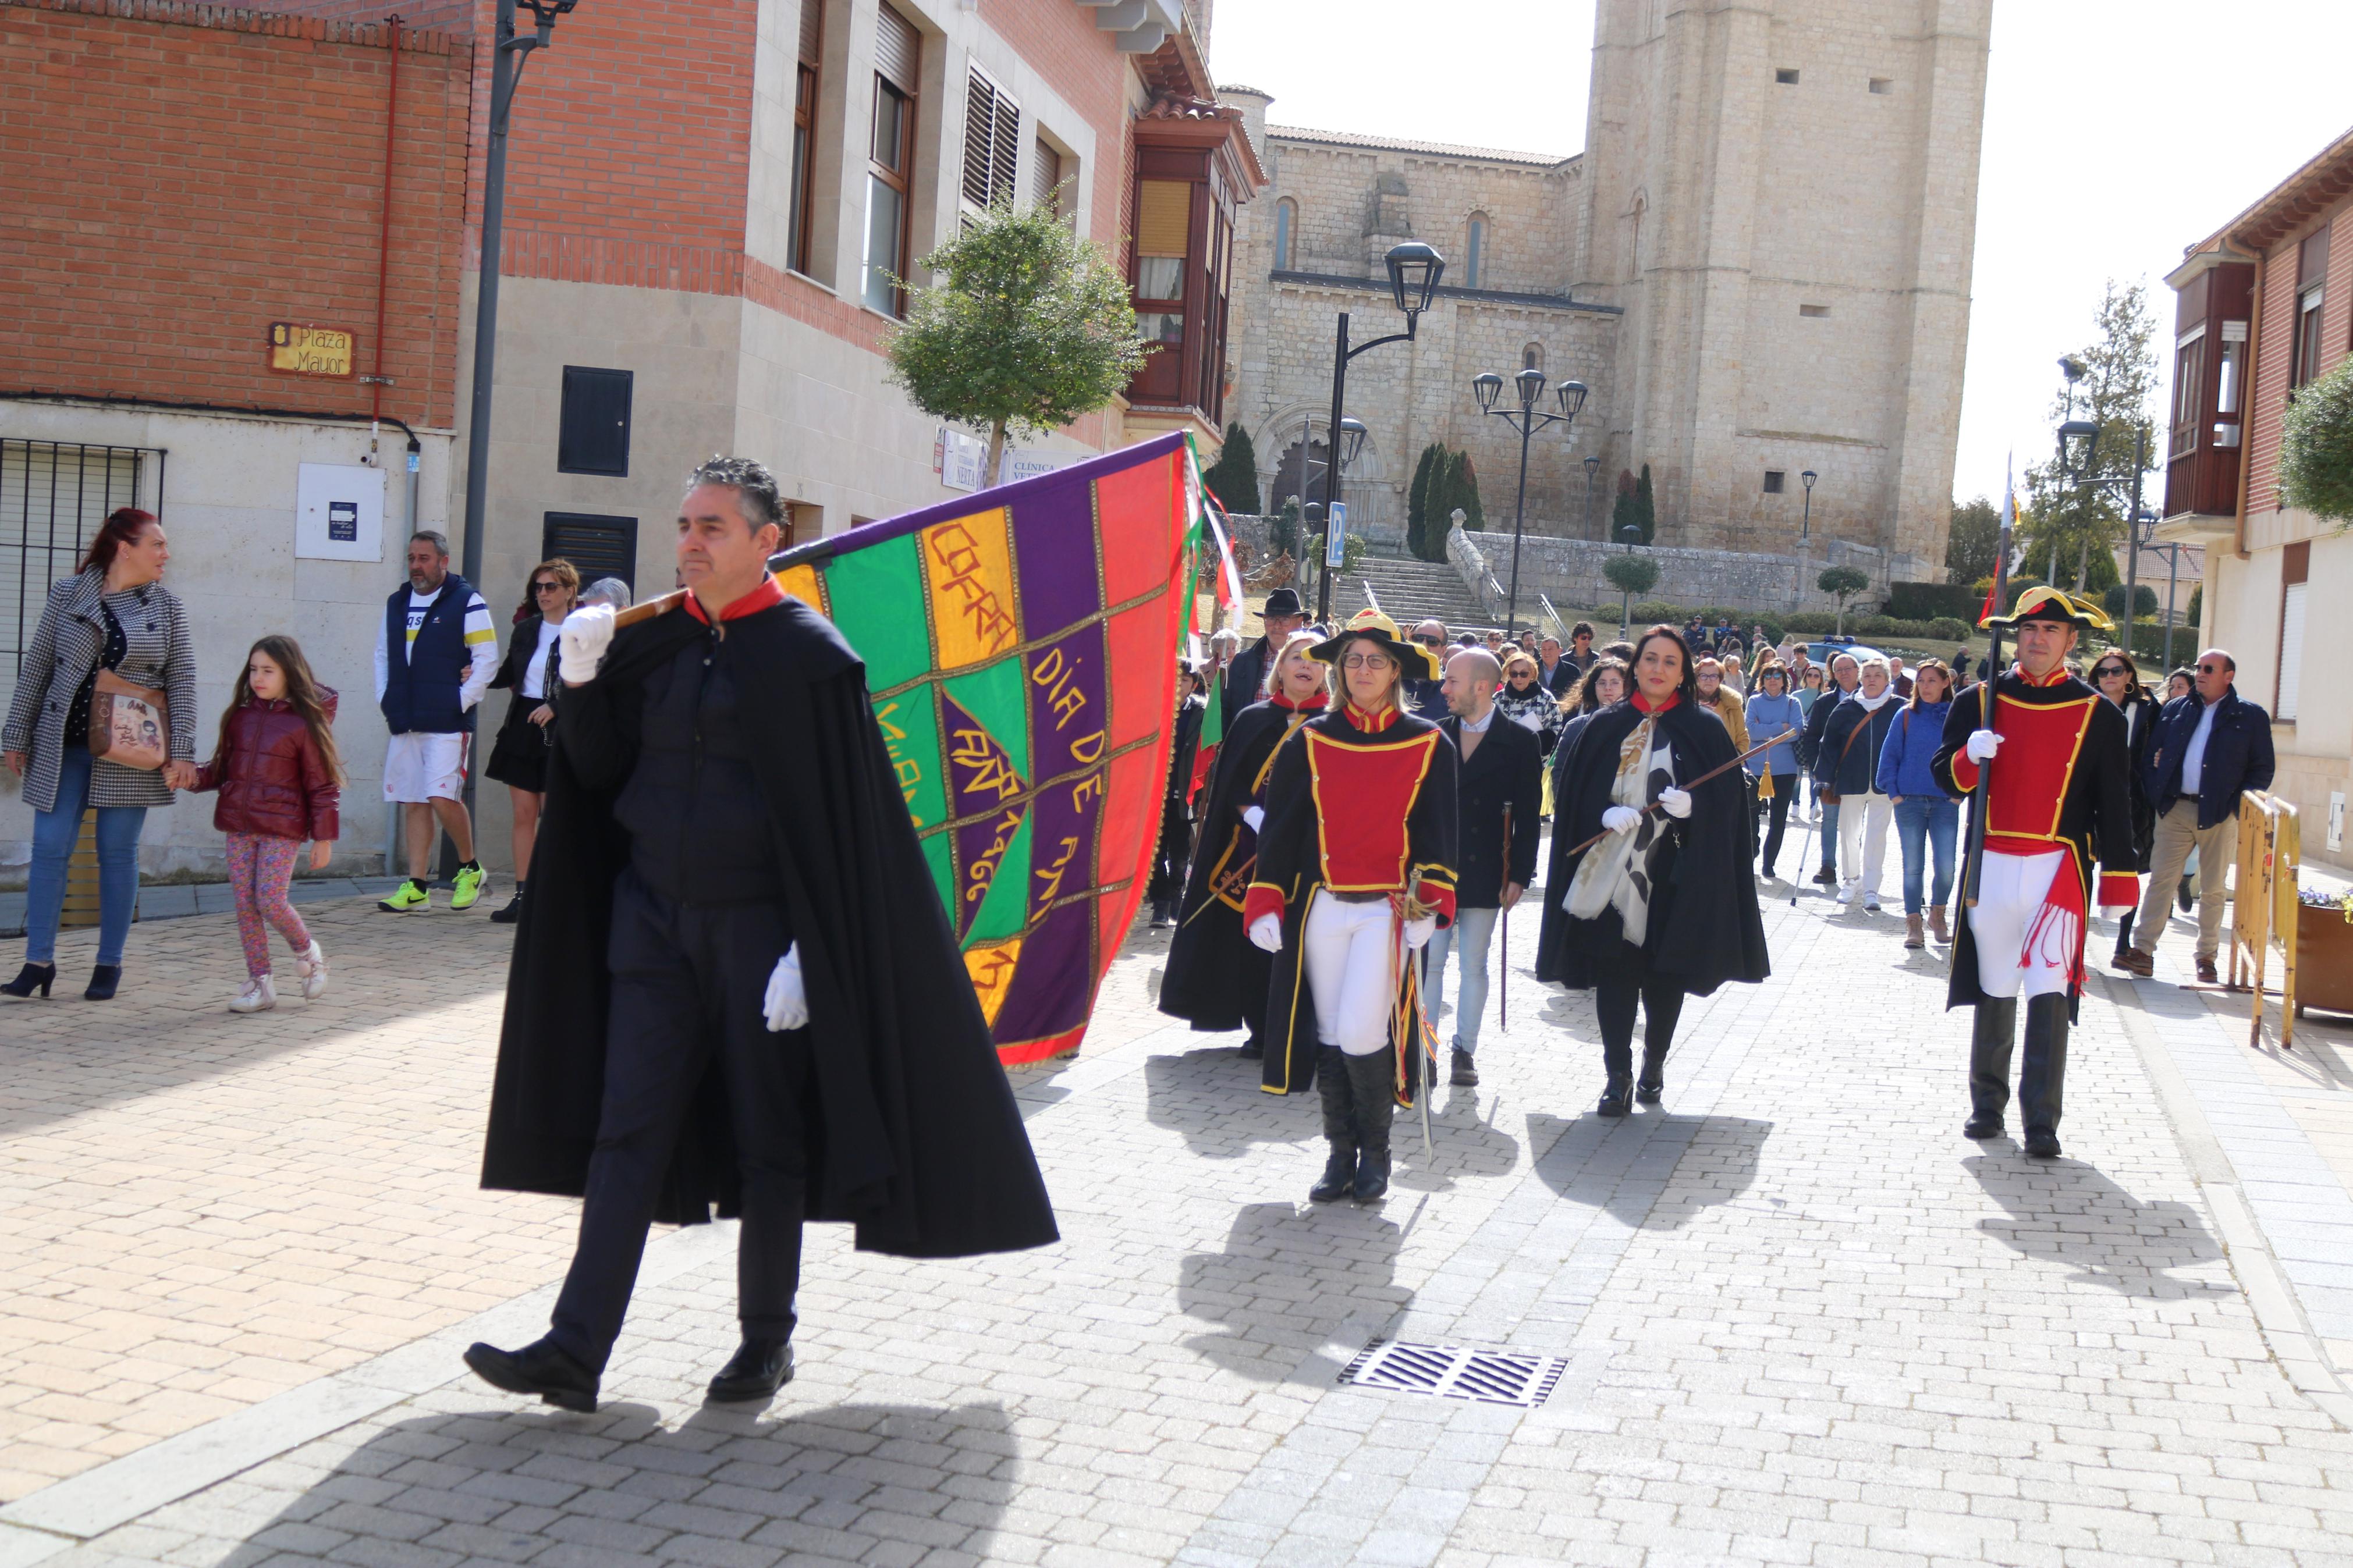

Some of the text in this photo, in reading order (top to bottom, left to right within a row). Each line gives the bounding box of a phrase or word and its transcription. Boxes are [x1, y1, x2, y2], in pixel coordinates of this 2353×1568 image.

[297, 327, 345, 349] Plaza
[294, 351, 345, 374] Mayor
[956, 465, 975, 486] NERTA
[1014, 461, 1055, 472] CLÍNICA
[1331, 511, 1342, 559] P
[931, 523, 1016, 655] COFRA
